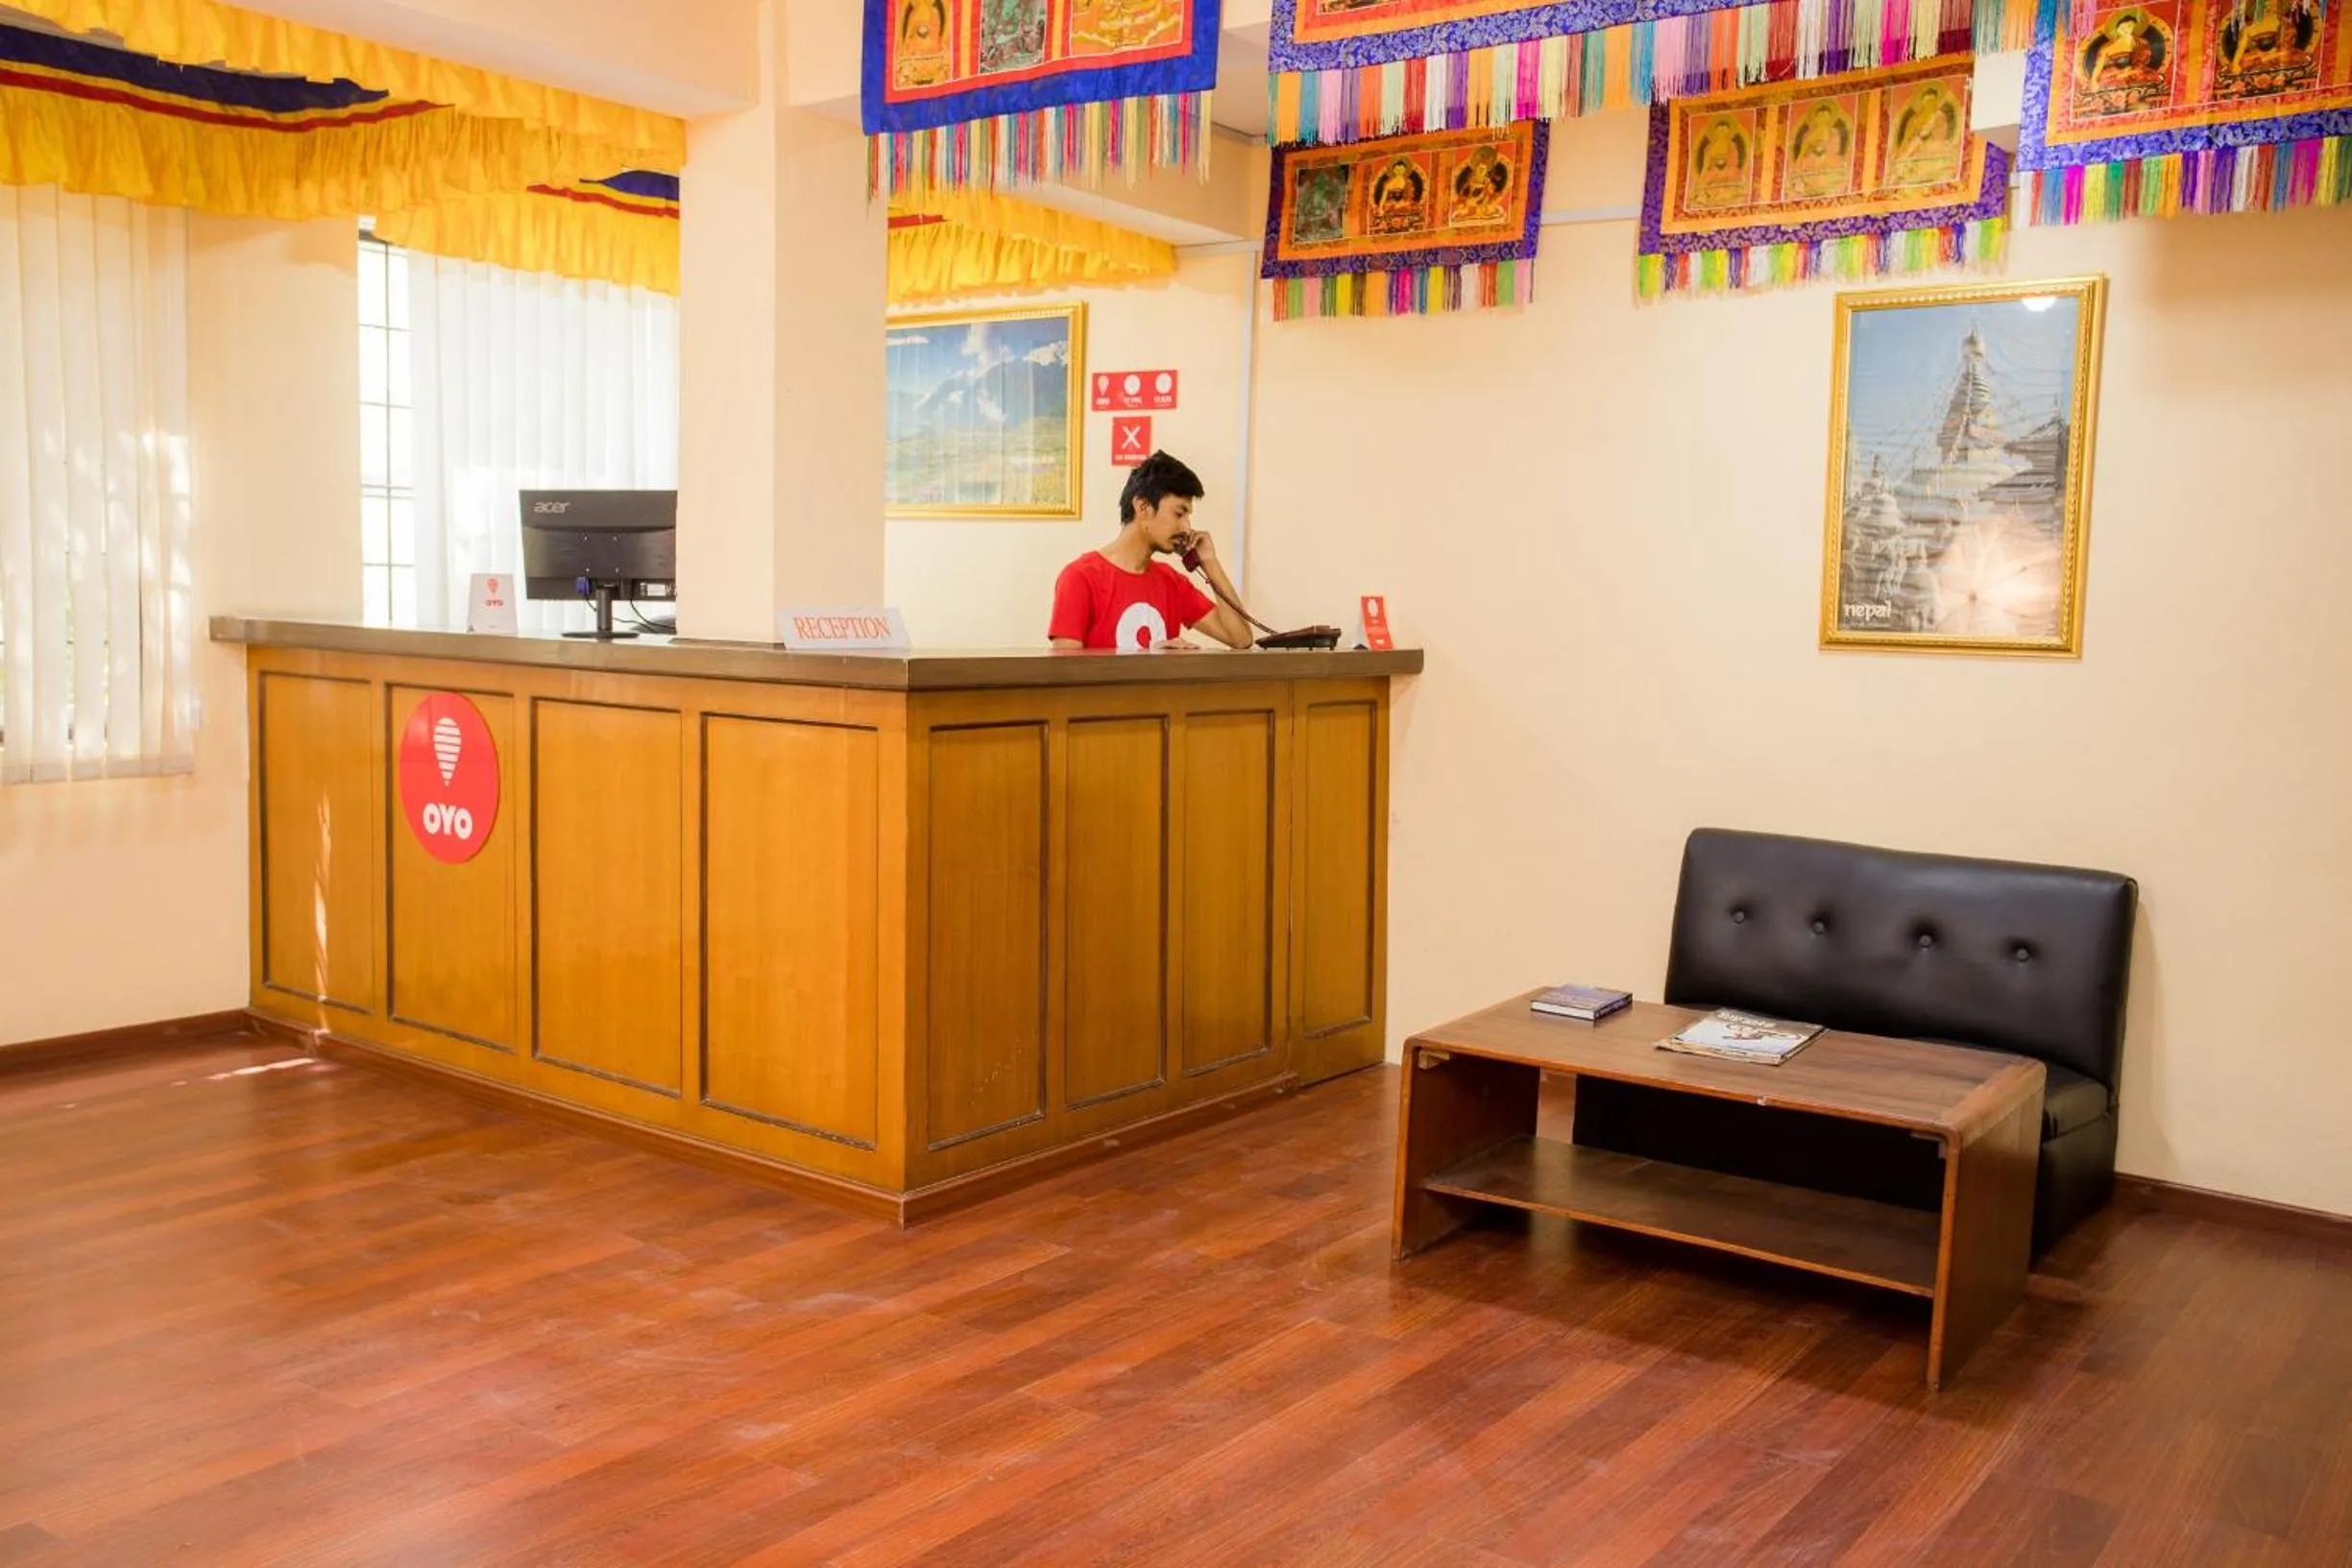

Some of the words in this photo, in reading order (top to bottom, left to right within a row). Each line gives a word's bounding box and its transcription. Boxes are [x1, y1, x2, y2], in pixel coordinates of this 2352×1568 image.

[534, 501, 571, 514] acer
[1844, 599, 1892, 621] nepal
[792, 615, 891, 639] RECEPTION
[423, 802, 473, 840] OYO
